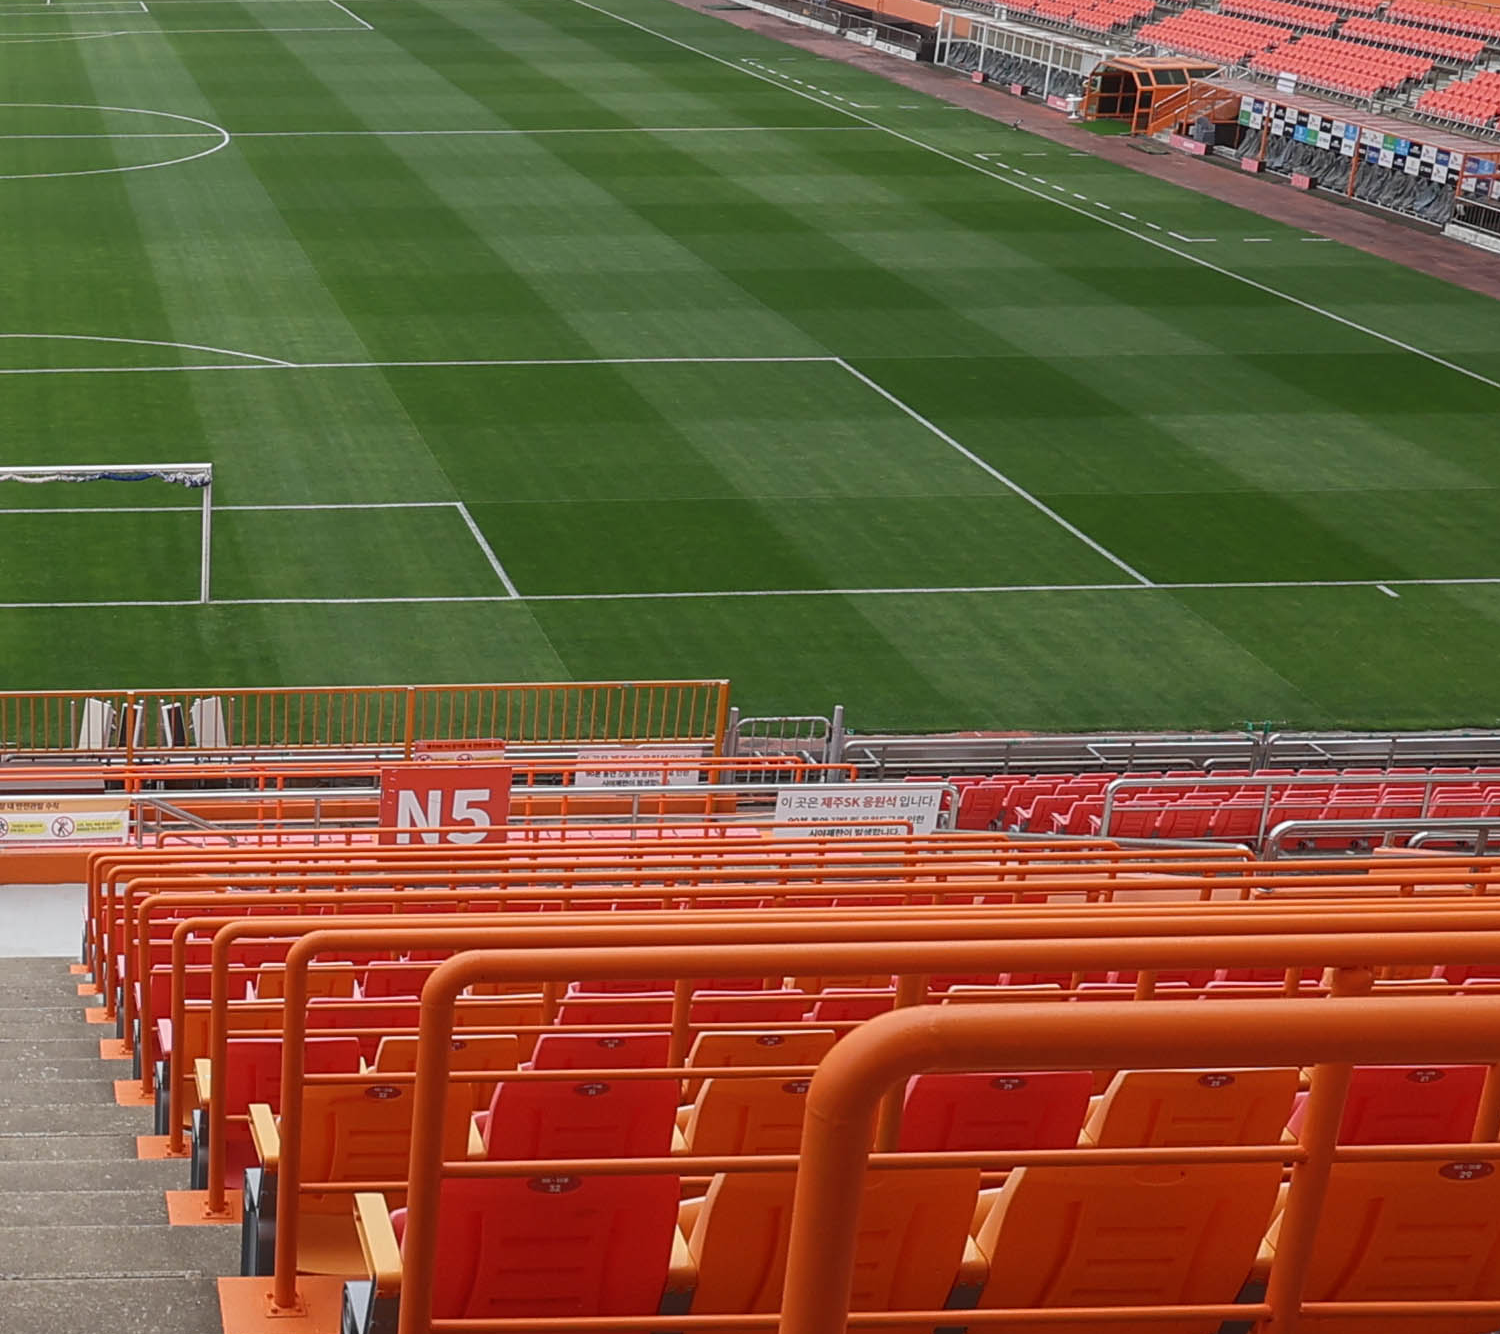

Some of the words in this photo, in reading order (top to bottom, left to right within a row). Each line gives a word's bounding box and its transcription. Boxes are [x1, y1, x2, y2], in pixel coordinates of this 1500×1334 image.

[396, 789, 491, 845] N5
[781, 797, 792, 808] 이
[795, 797, 819, 809] 곳은
[820, 796, 860, 808] 제주SK
[863, 796, 898, 808] 응원석
[900, 795, 936, 808] 입니다.
